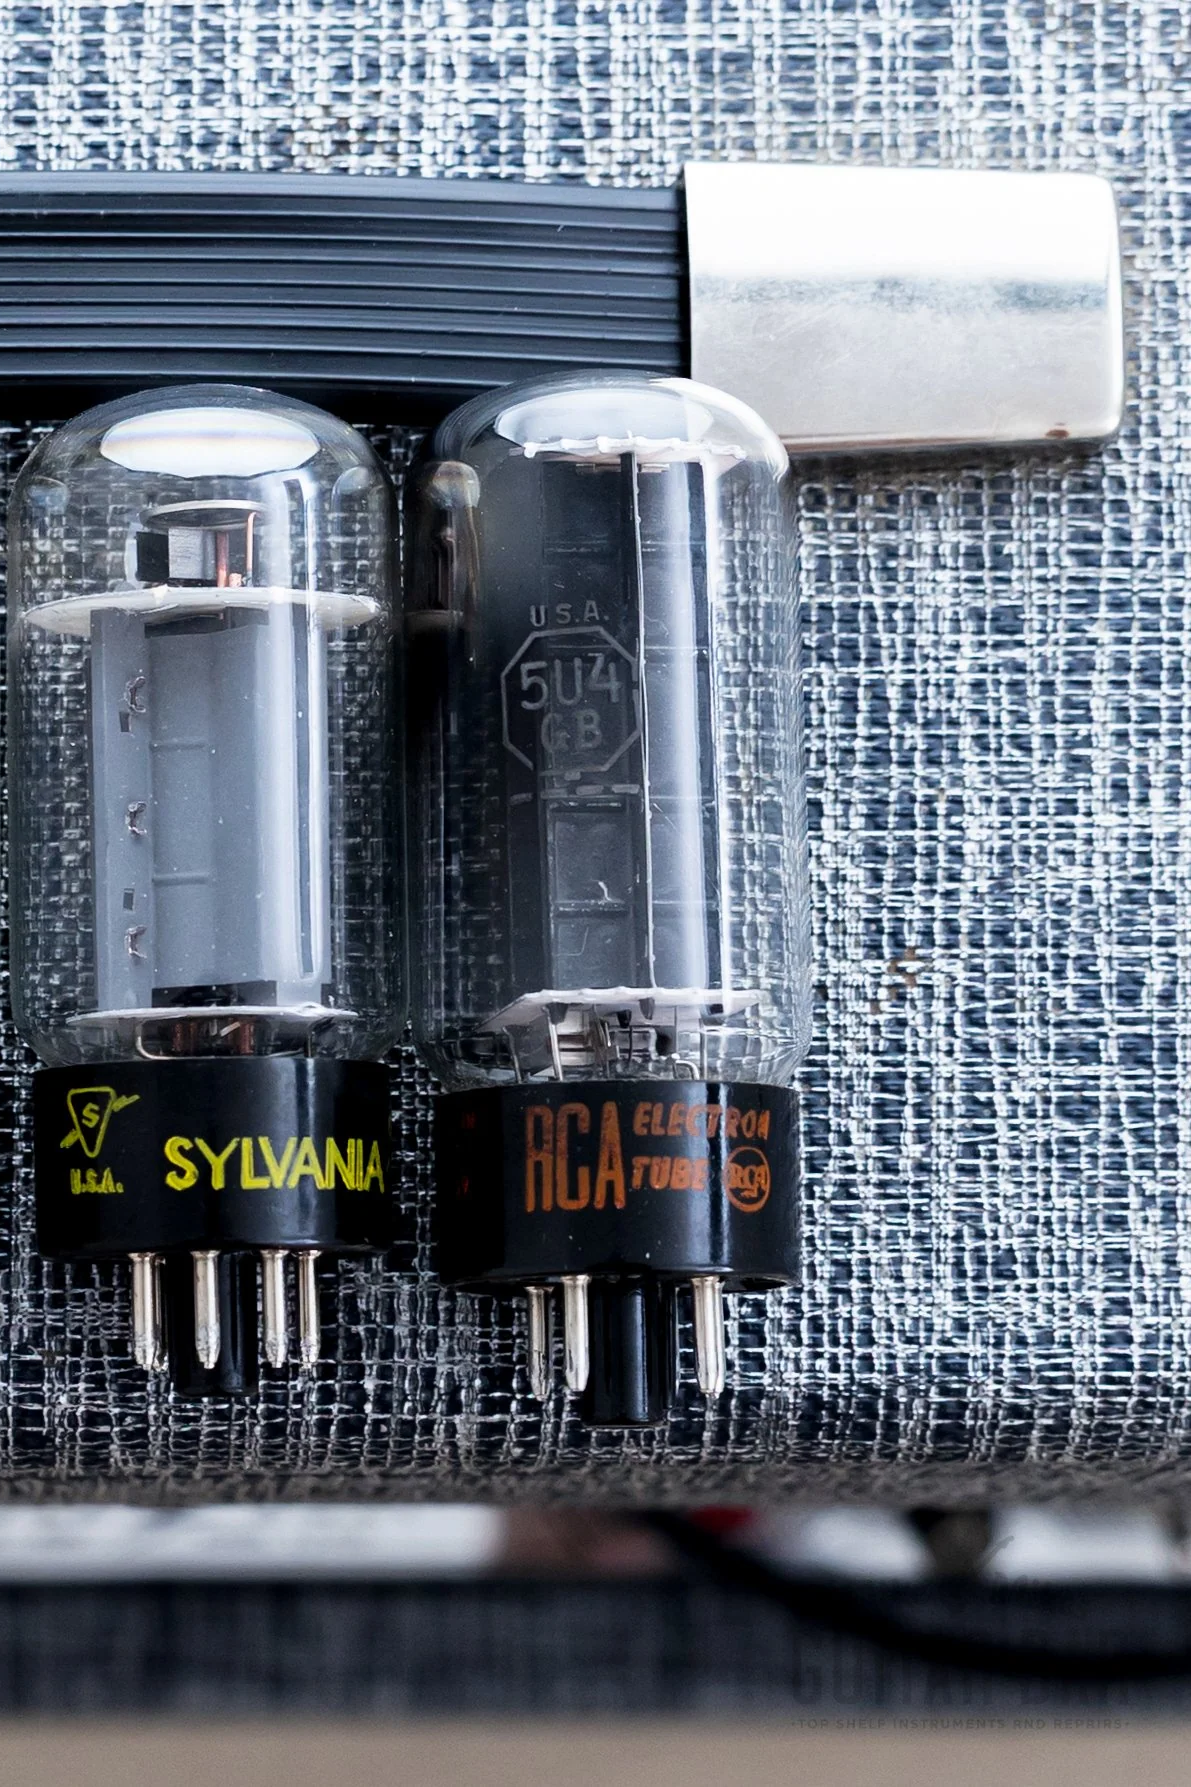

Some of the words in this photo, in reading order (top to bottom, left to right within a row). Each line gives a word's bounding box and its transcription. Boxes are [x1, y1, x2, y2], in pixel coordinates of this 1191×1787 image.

[519, 652, 623, 711] 5U4
[540, 707, 604, 751] GB
[633, 1102, 770, 1141] ELECTRON
[164, 1135, 385, 1194] SYLVANIA
[525, 1101, 627, 1214] RCA
[631, 1155, 712, 1191] TUBE
